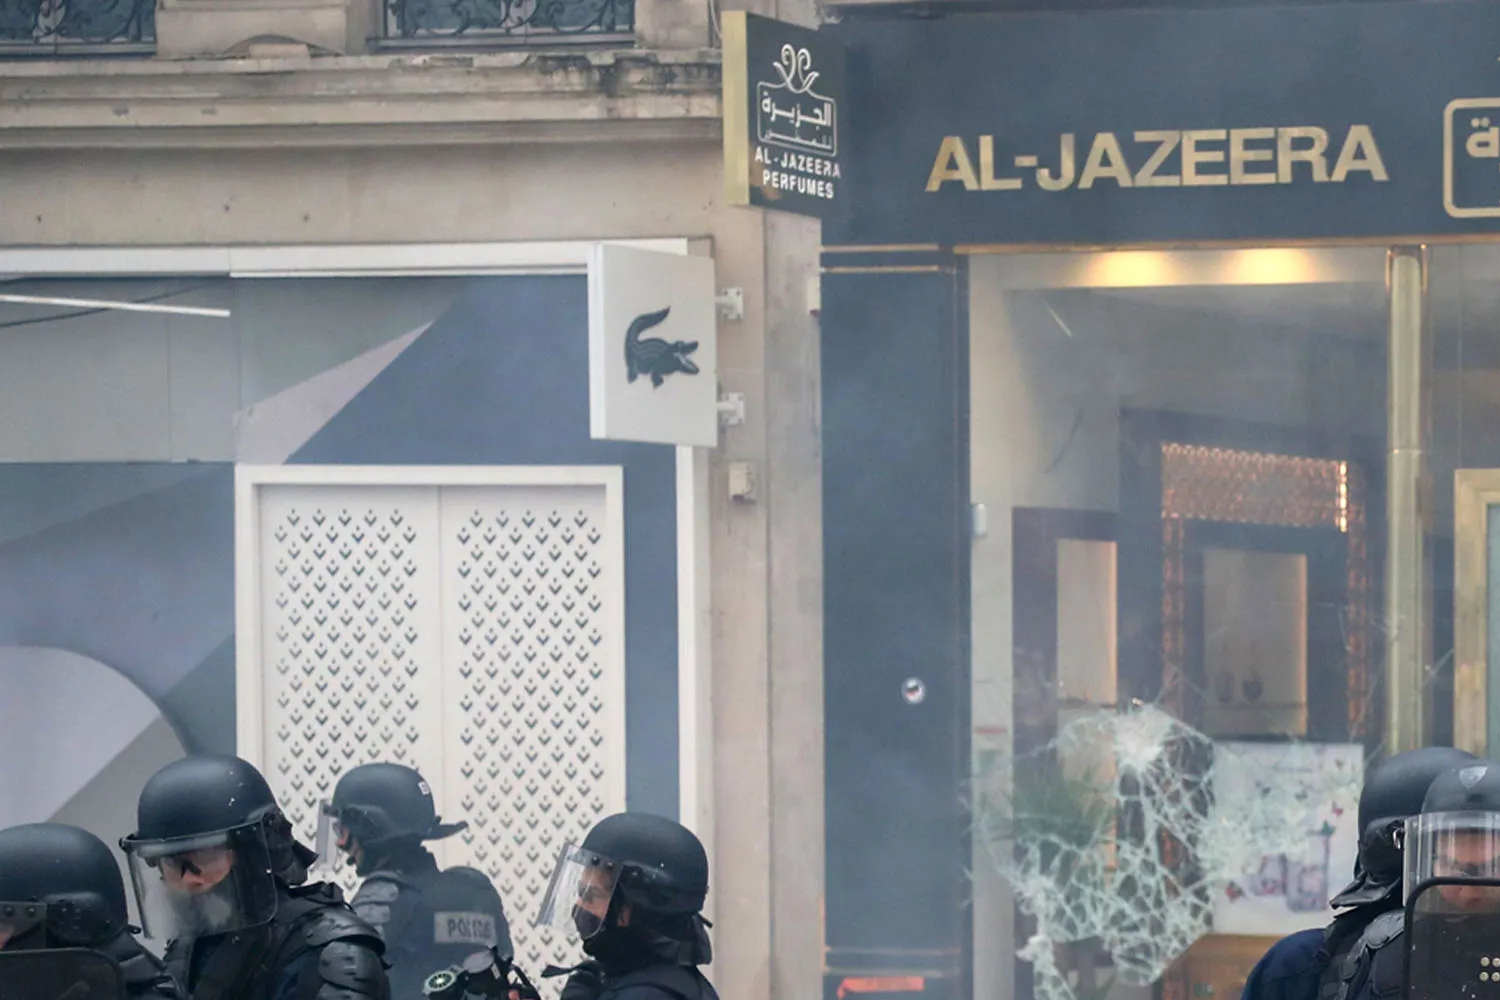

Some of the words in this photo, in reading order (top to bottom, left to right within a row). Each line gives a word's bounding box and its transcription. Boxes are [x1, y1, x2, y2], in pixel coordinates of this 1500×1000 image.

[754, 145, 841, 179] AL-JAZEERA
[925, 124, 1389, 192] AL-JAZEERA
[762, 169, 834, 199] PERFUMES
